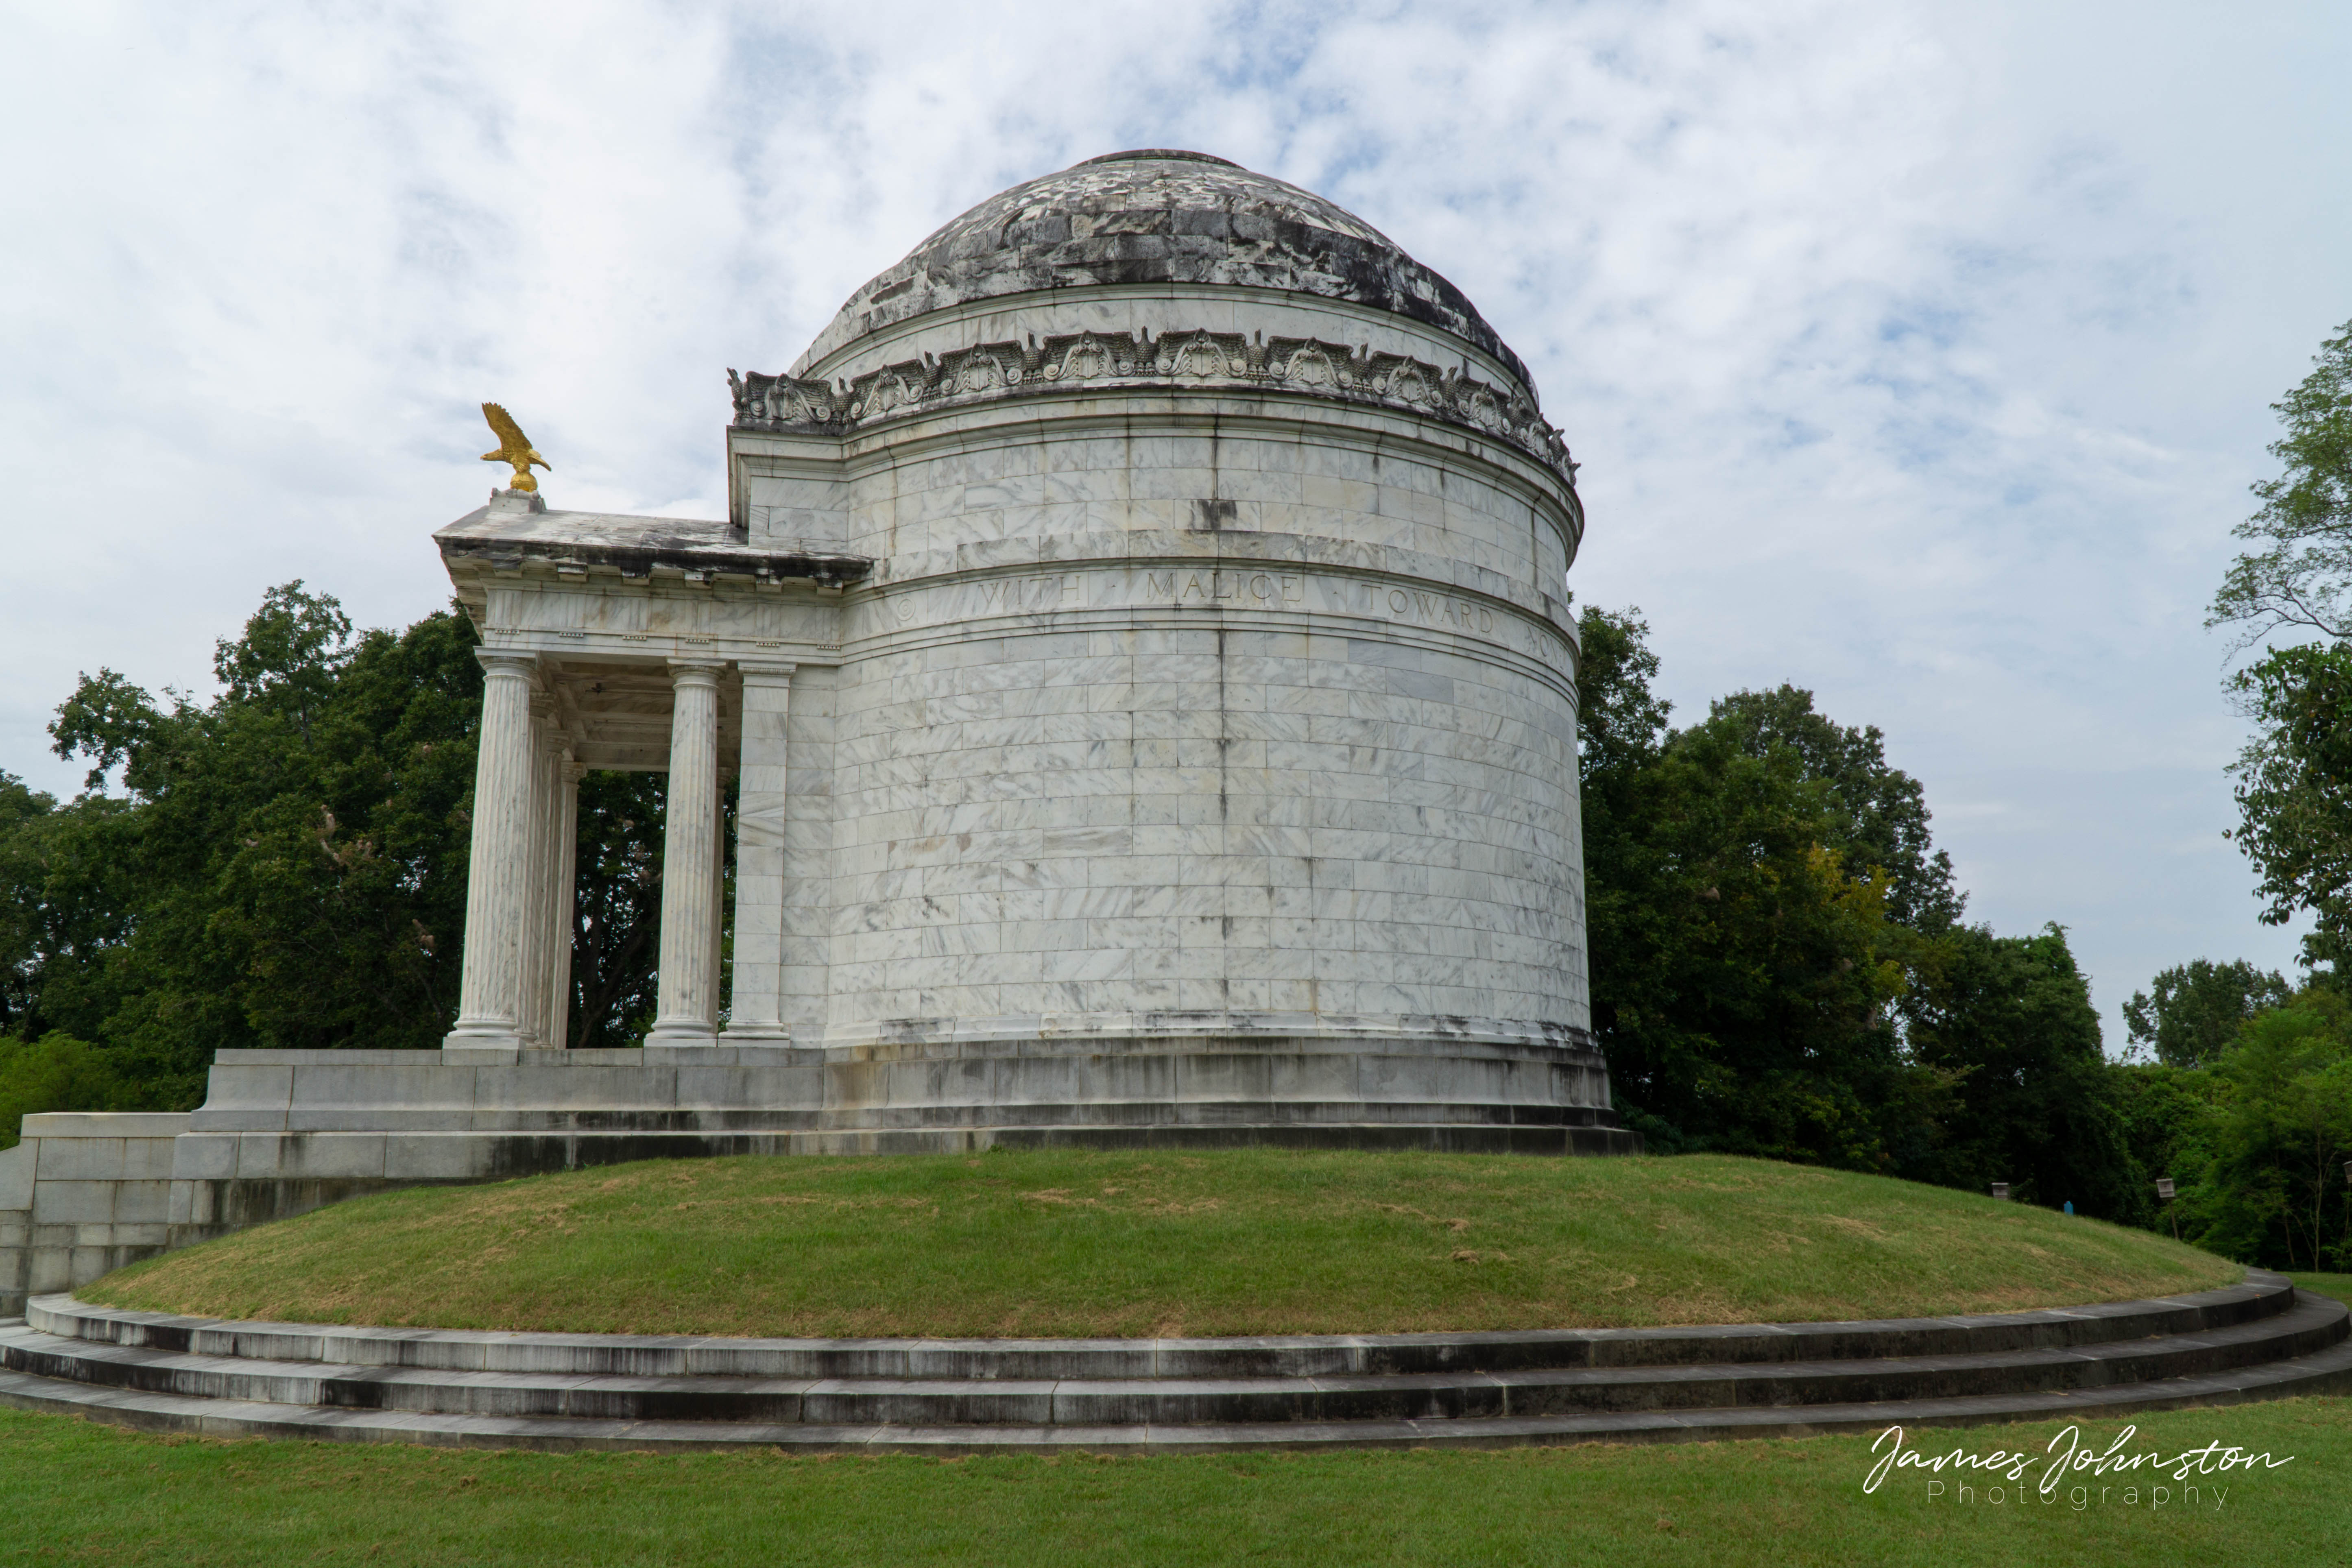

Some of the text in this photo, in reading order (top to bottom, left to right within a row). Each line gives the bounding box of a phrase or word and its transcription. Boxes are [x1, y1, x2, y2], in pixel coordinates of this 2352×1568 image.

[978, 576, 1081, 605] WITH
[1147, 572, 1301, 602] MALICE
[1361, 584, 1493, 633] TOWARD
